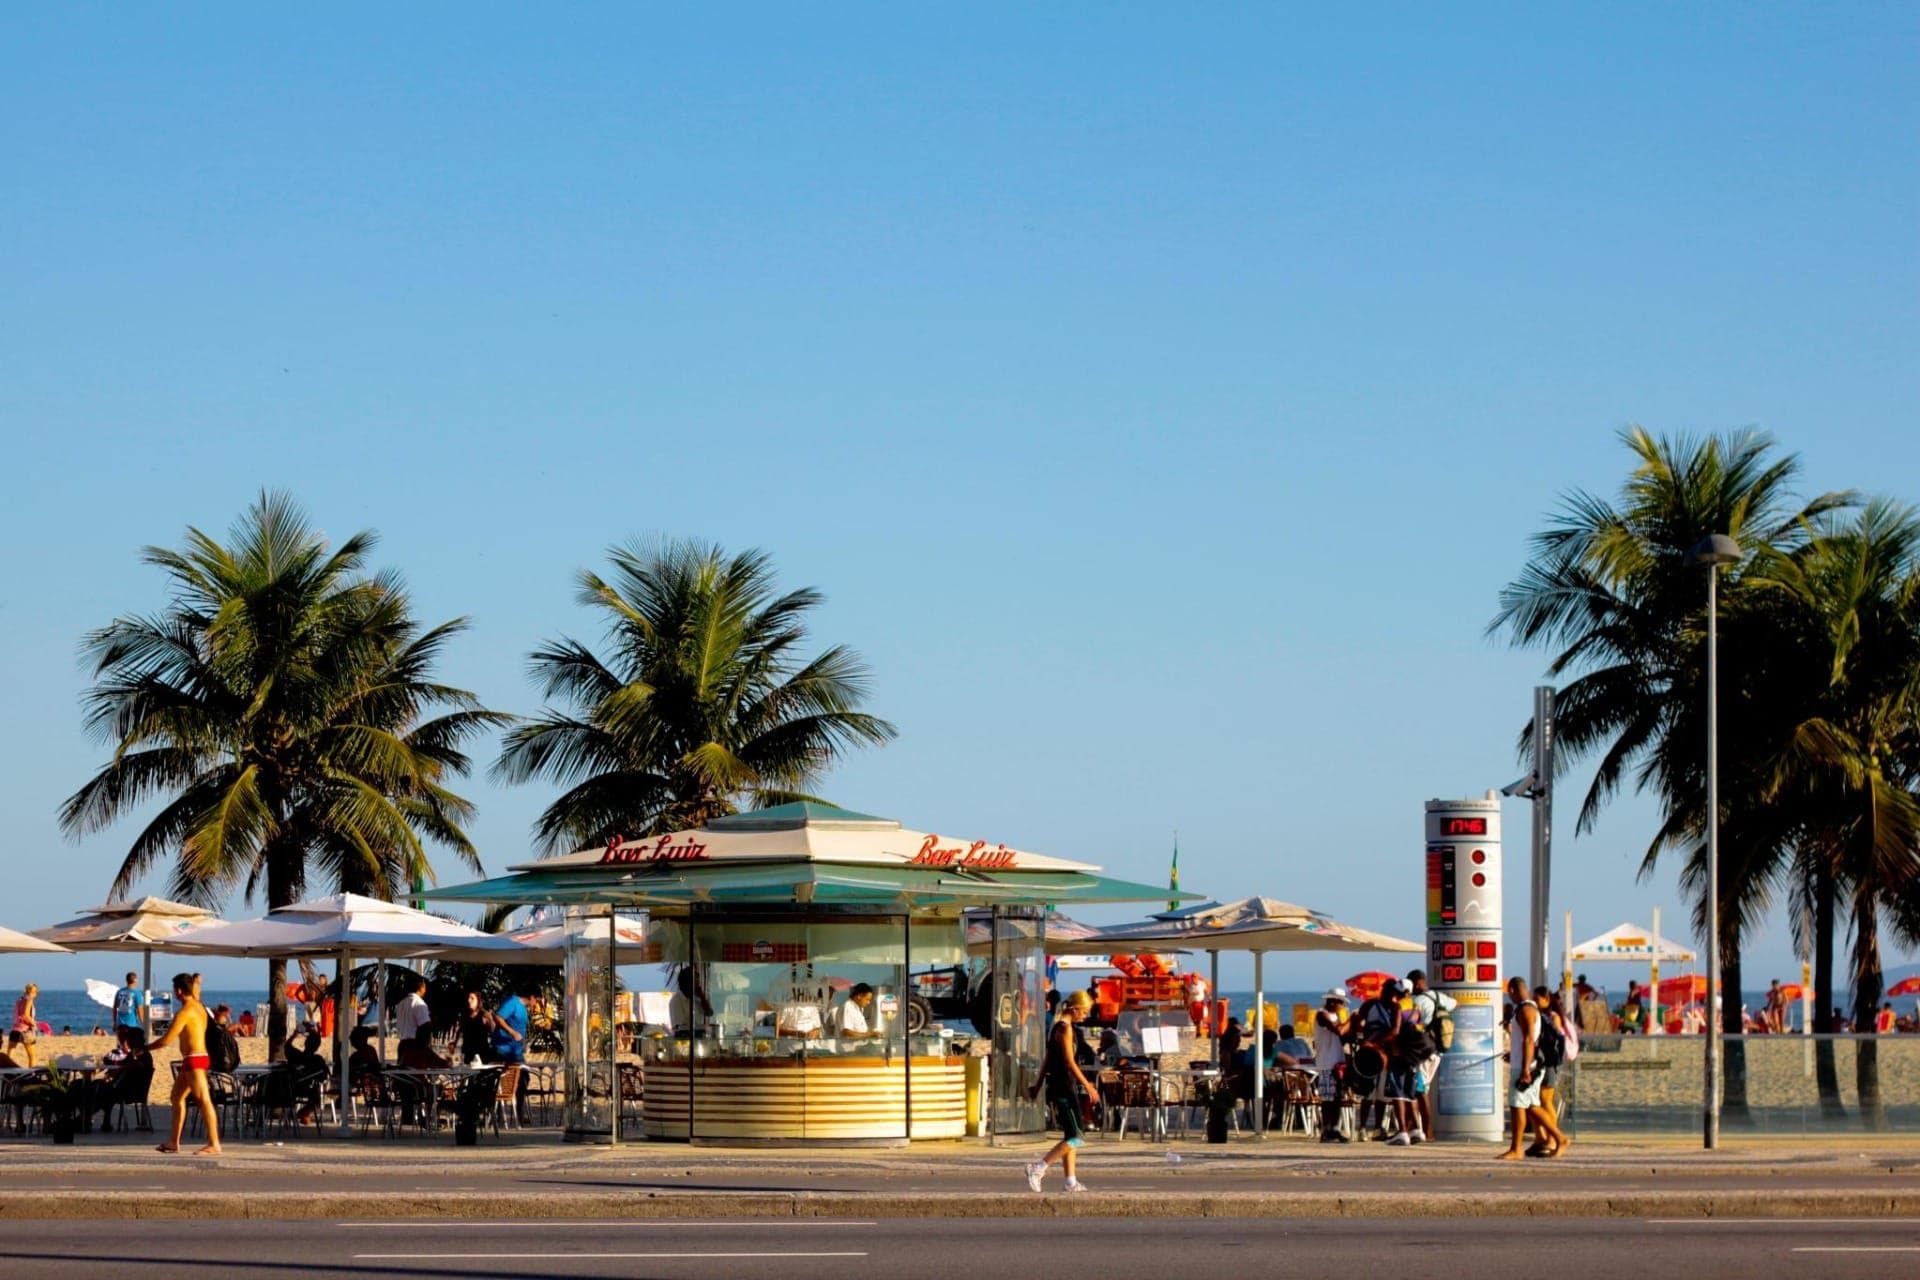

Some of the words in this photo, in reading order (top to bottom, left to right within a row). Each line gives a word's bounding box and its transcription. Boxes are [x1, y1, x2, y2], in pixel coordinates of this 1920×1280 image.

[600, 834, 649, 863] Bar
[646, 834, 711, 862] Luiz
[911, 833, 962, 865] Bar
[961, 839, 1017, 868] Luiz
